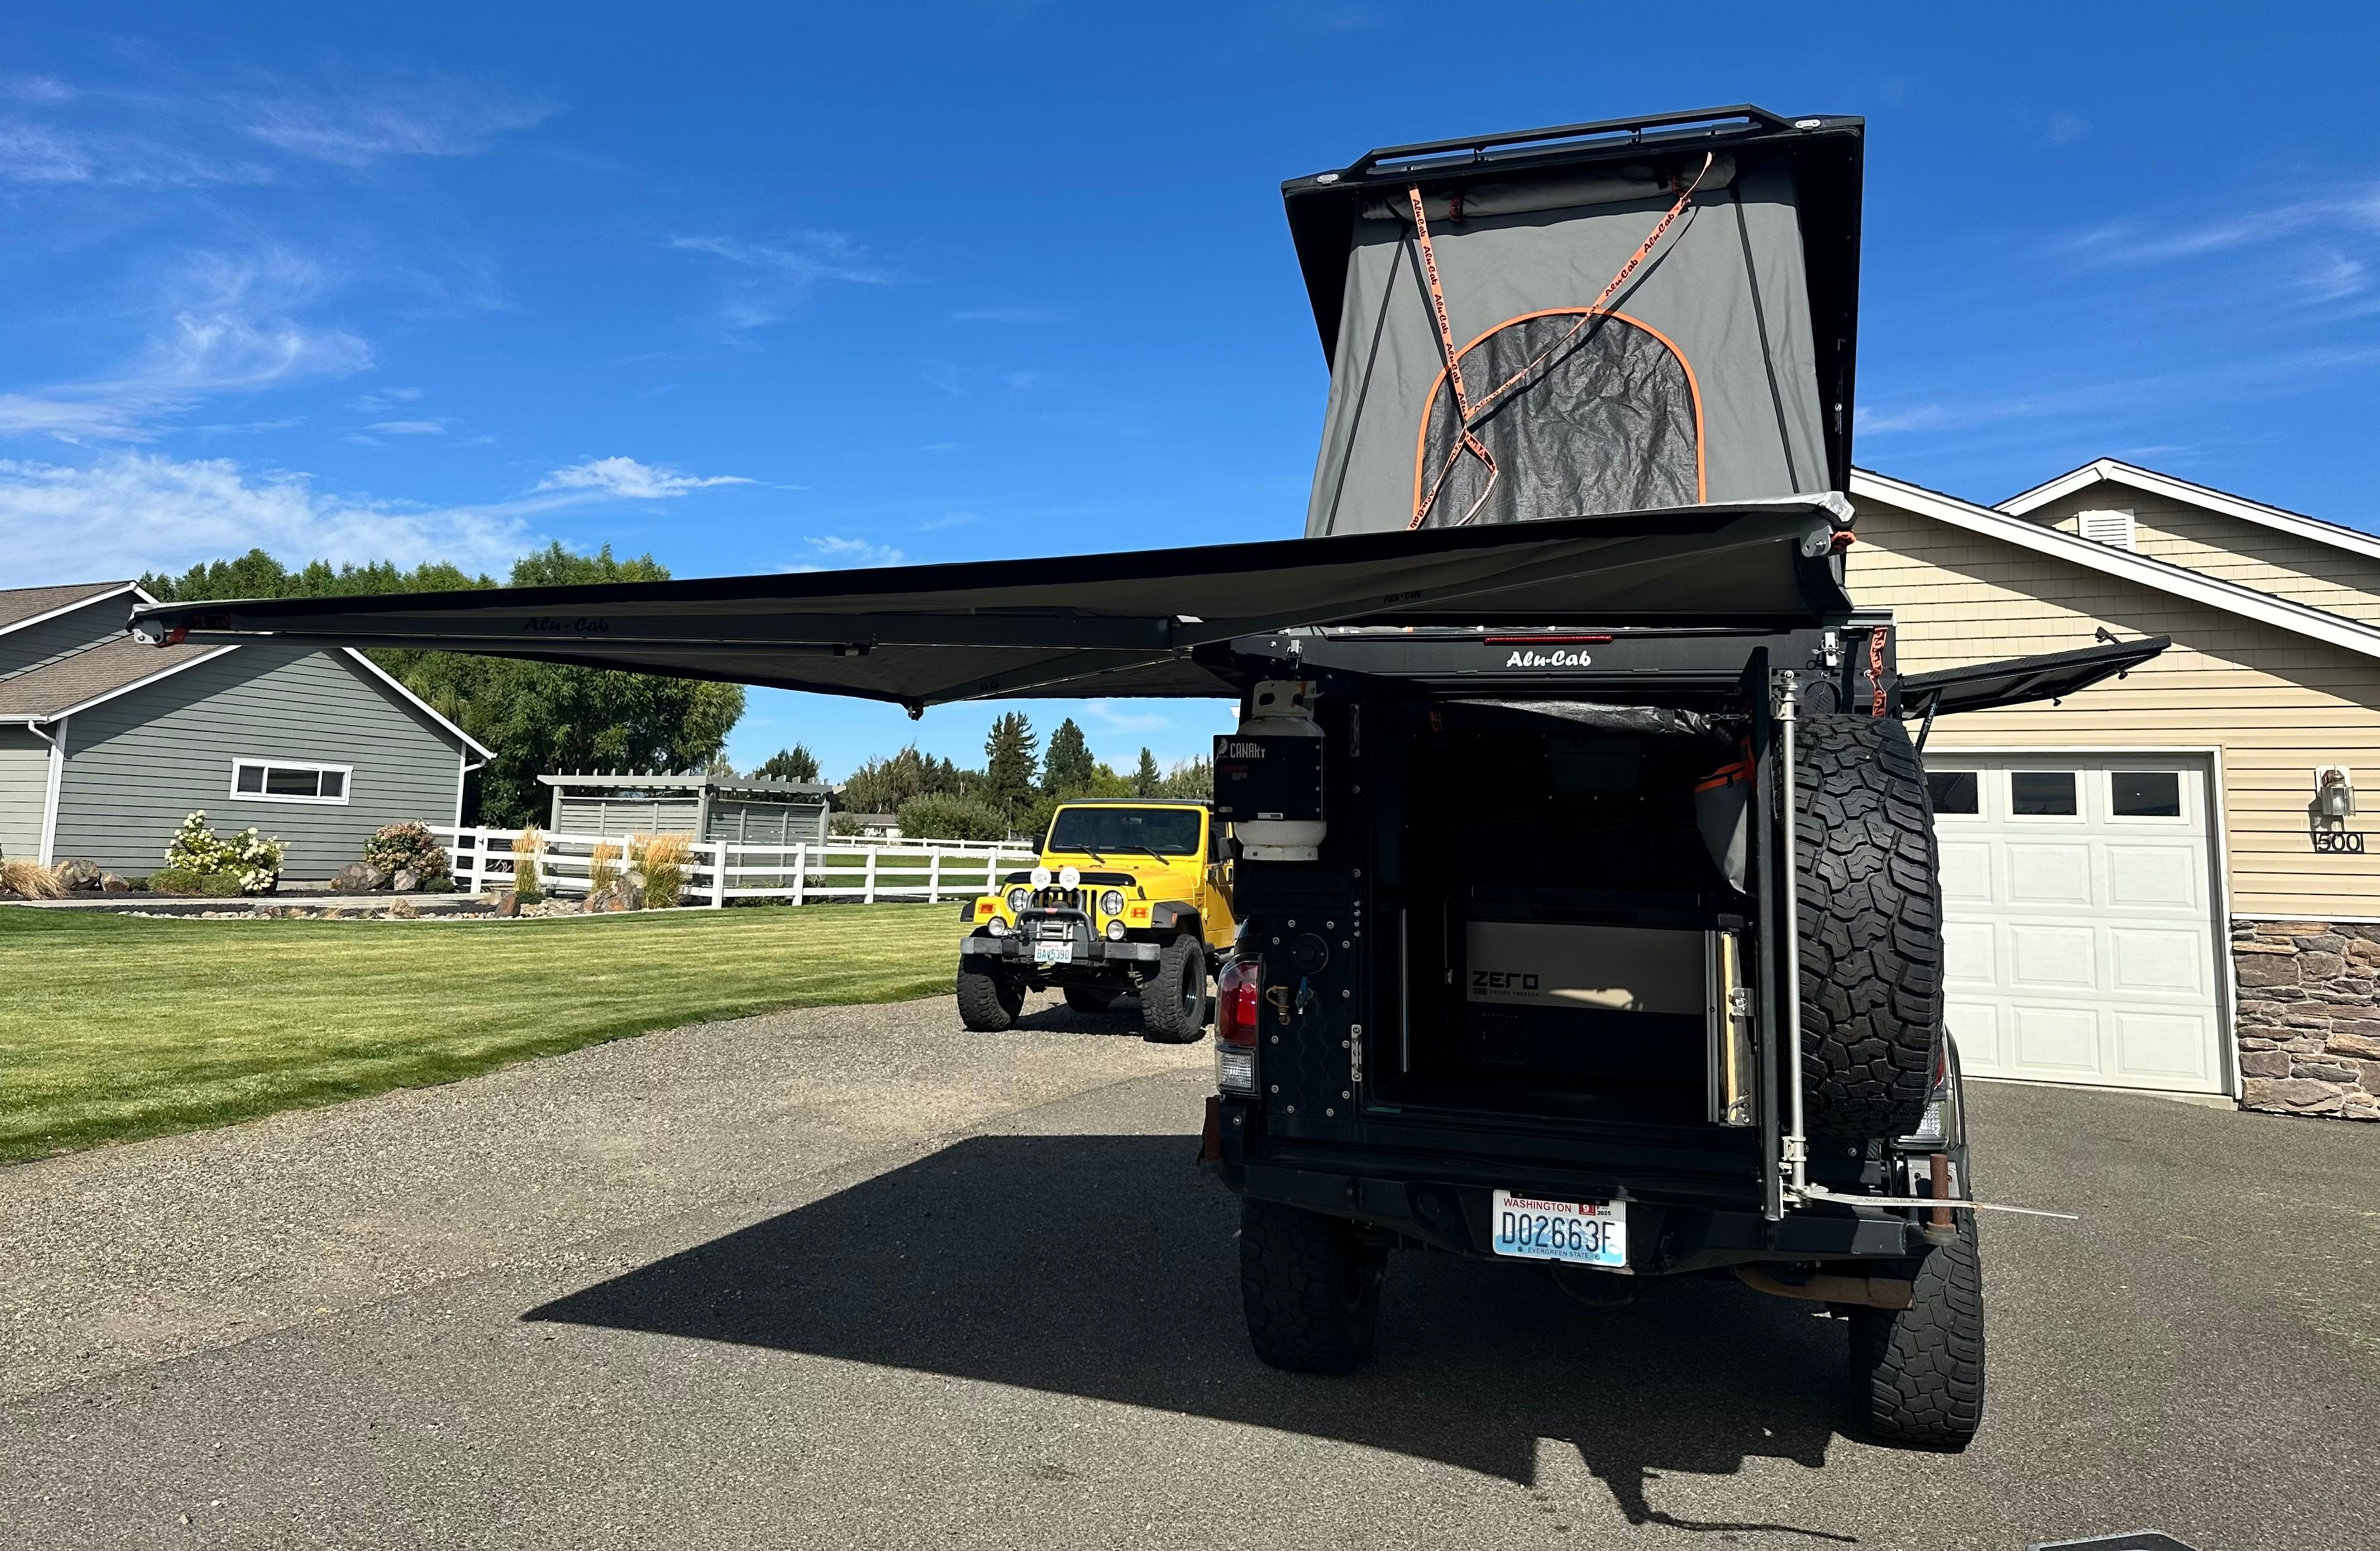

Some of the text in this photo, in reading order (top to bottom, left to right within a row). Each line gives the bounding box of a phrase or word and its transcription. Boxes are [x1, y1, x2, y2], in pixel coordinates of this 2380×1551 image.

[1413, 199, 1427, 238] Alu-Cab
[1644, 213, 1675, 253] Alu-Cab
[1423, 245, 1438, 285] Alu-Cab
[1605, 259, 1638, 297] Alu-Cab
[1434, 294, 1448, 334] Alu-Cab
[1446, 342, 1461, 384] Alu-Cab
[522, 616, 608, 633] Alu-Cab
[1506, 650, 1591, 668] Alu-Cab
[1230, 743, 1266, 758] CANARY
[1037, 949, 1070, 960] BAV5390
[1503, 1198, 1589, 1213] WASHINGTON 9
[1503, 1212, 1615, 1254] D02663F
[1528, 1247, 1567, 1256] EVERGREEN
